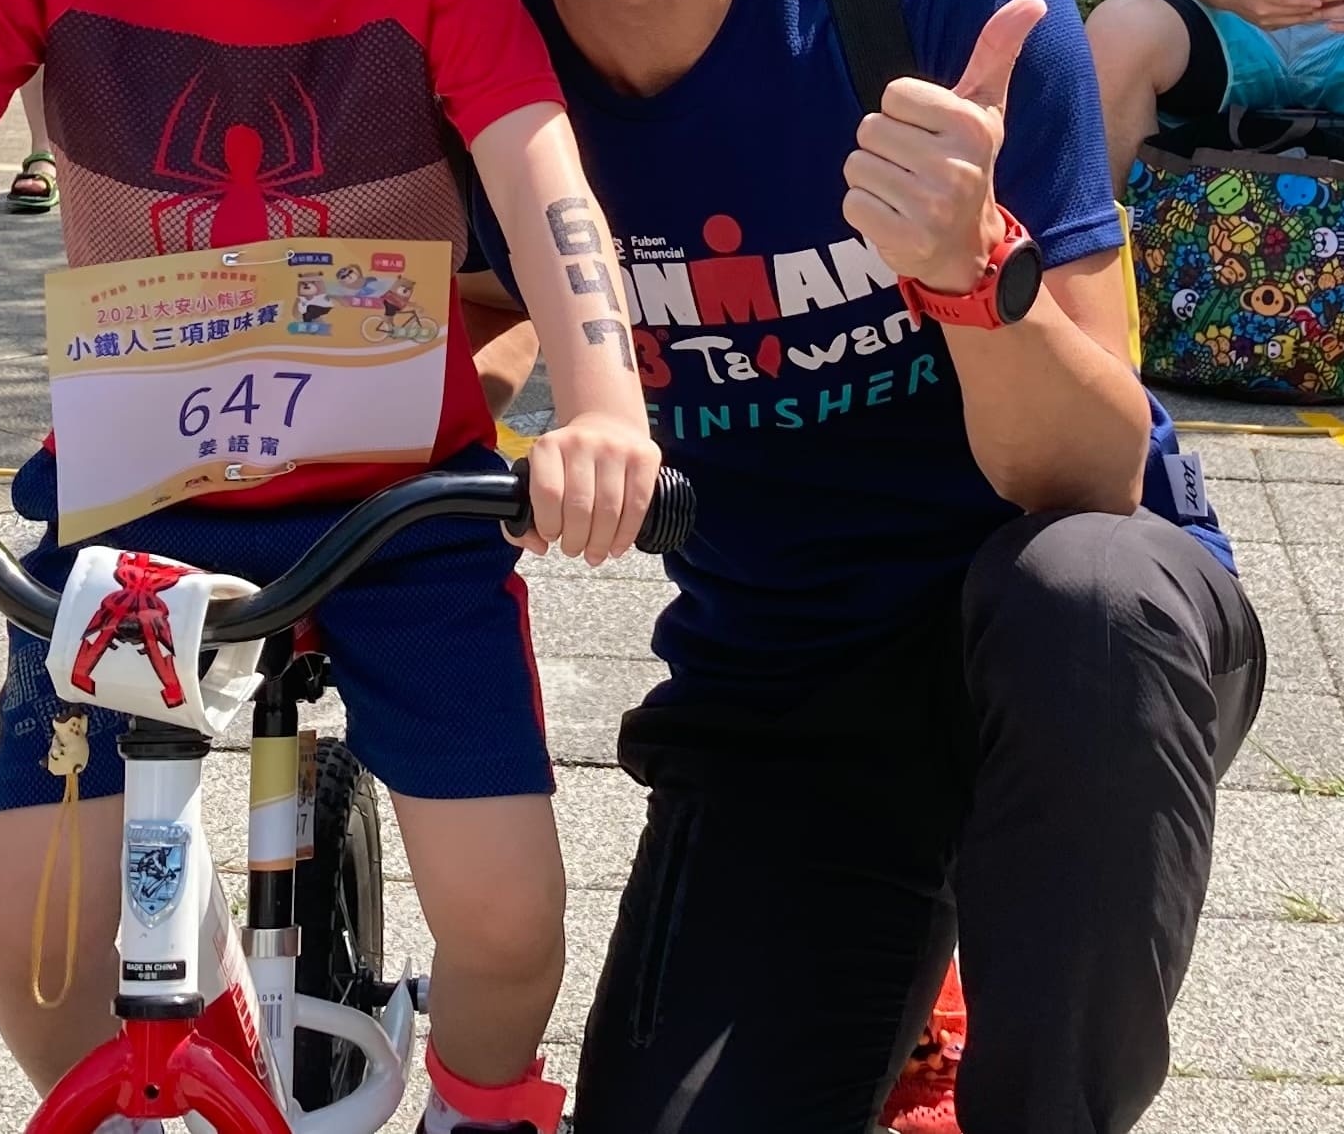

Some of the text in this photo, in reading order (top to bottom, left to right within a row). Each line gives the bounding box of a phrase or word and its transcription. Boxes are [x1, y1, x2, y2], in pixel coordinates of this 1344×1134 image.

[631, 235, 667, 247] Fubon
[633, 246, 685, 260] Financial
[546, 197, 635, 373] 647
[97, 289, 255, 324] 2021大安小熊盃
[67, 304, 279, 361] 小鐵人三項趣味賽
[179, 372, 312, 436] 647
[153, 962, 178, 971] CHINA
